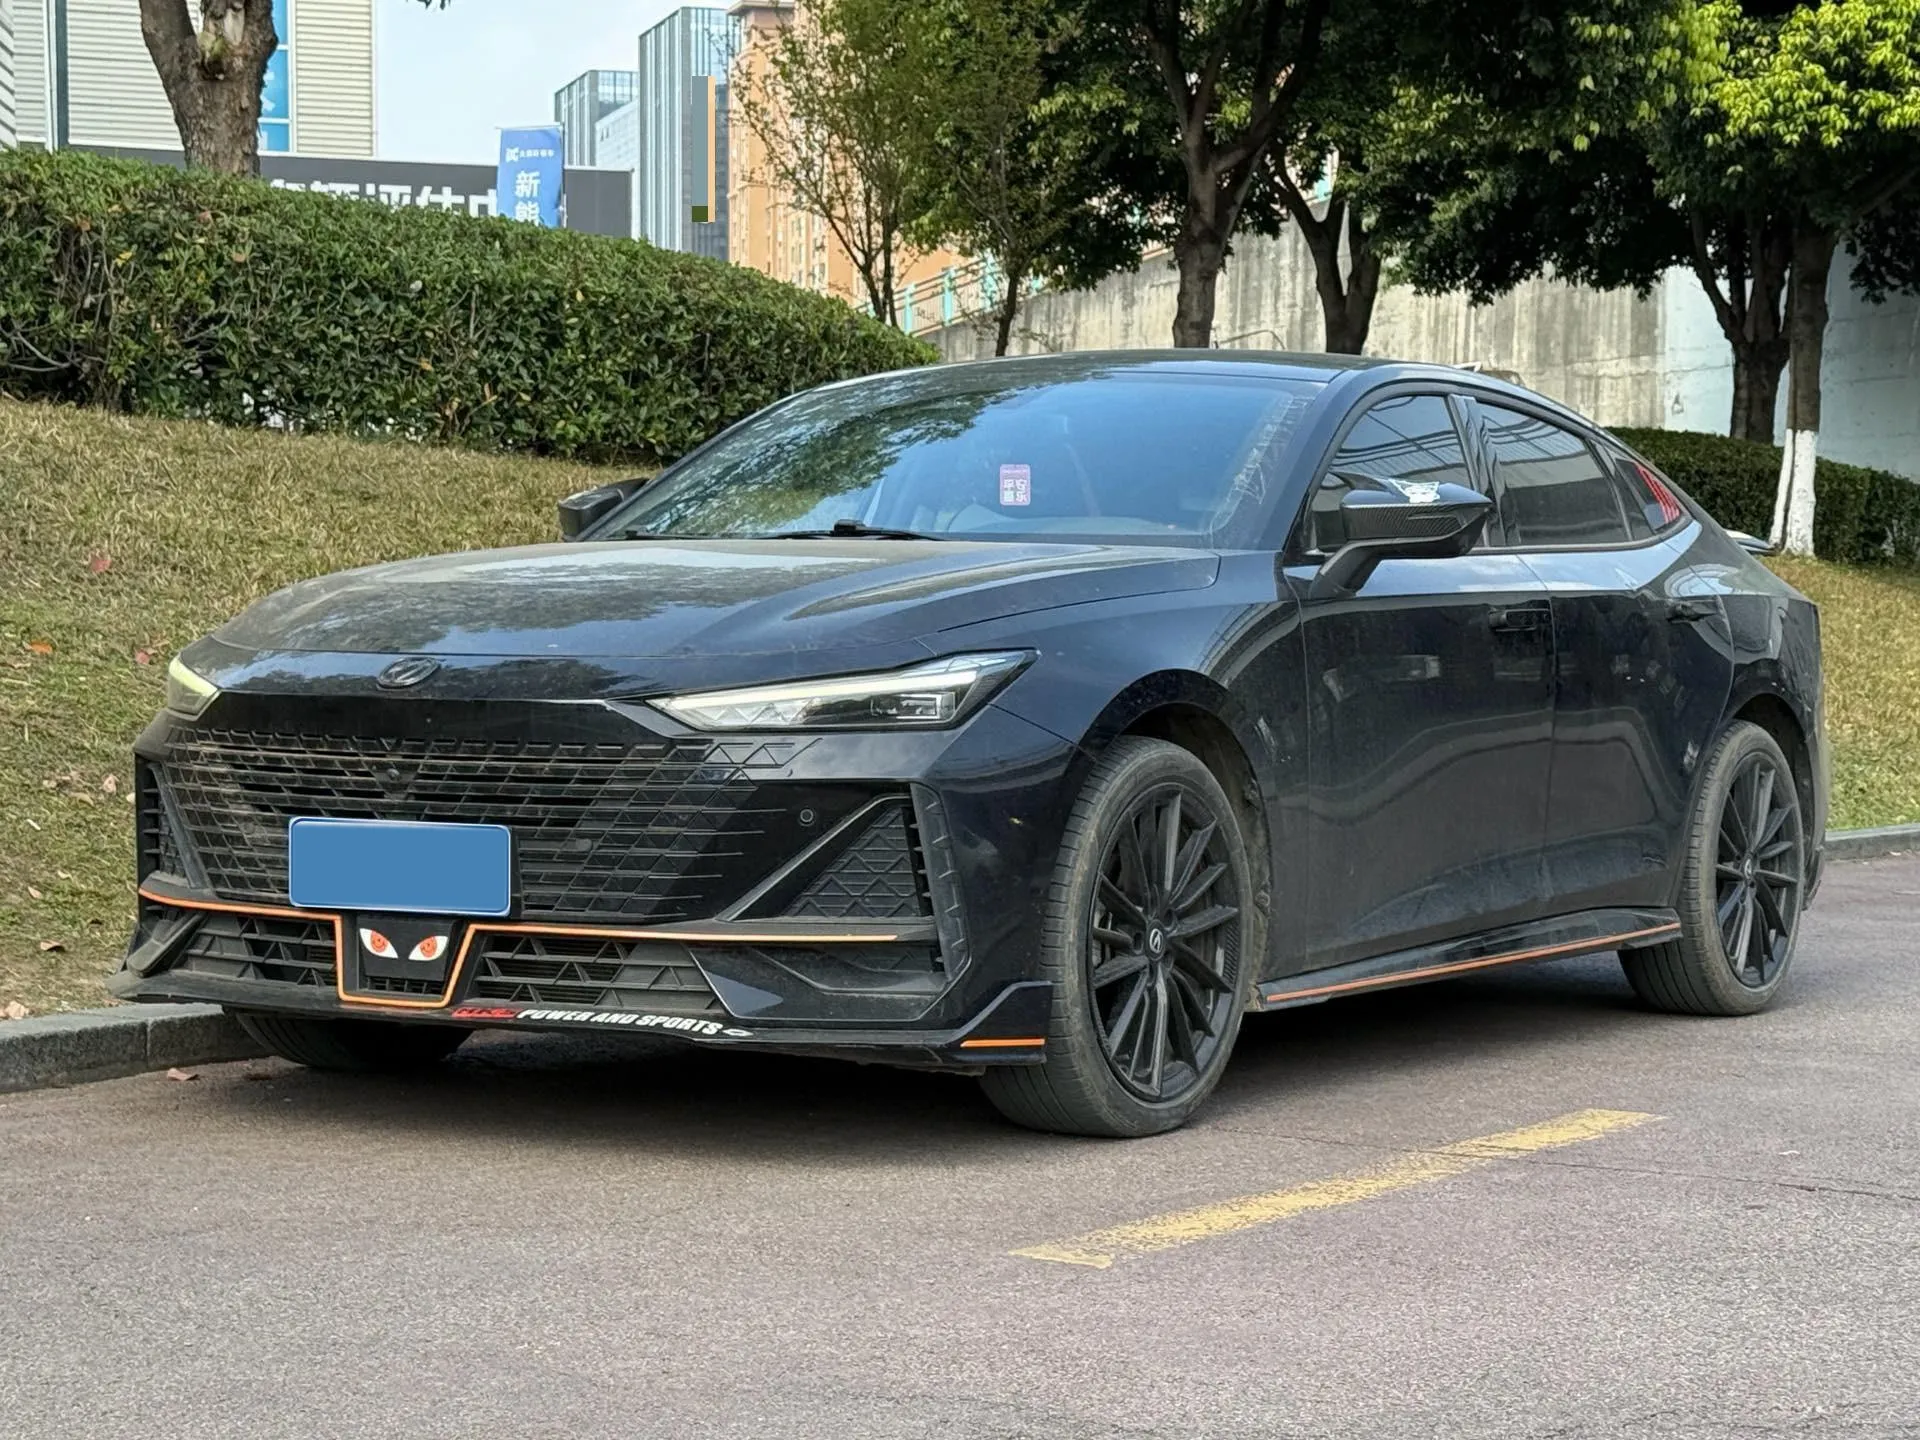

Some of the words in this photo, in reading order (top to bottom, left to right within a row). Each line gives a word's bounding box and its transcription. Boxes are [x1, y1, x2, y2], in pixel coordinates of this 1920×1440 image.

[516, 1009, 595, 1022] POWER
[590, 1012, 639, 1025] AND
[635, 1014, 723, 1035] SPORTS
